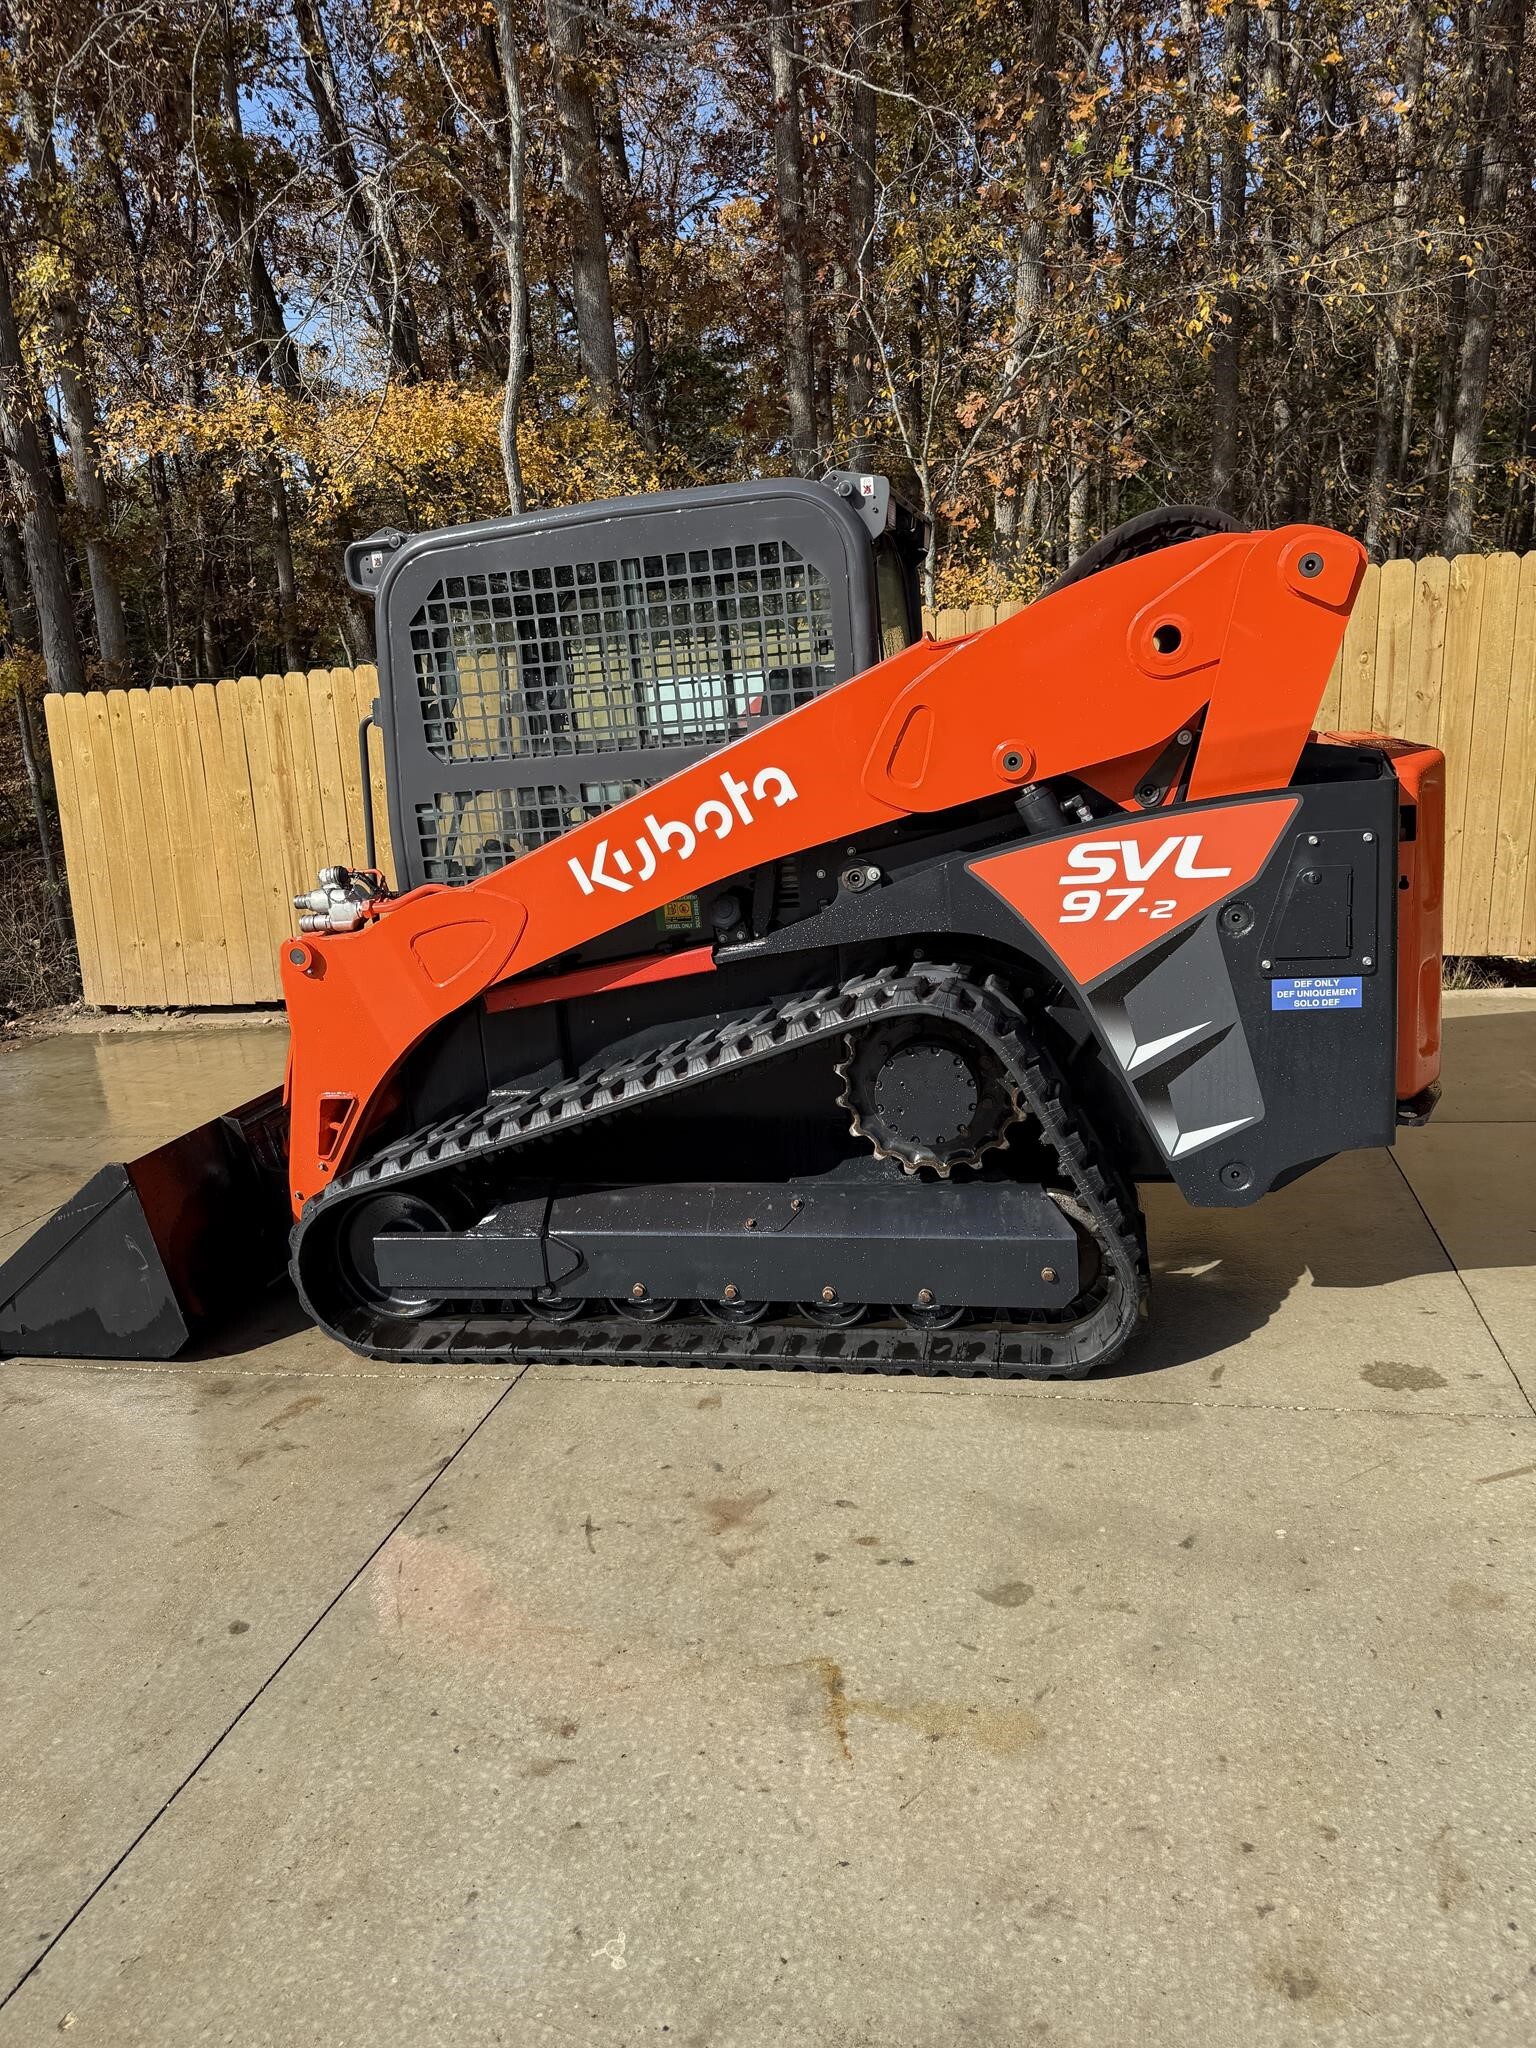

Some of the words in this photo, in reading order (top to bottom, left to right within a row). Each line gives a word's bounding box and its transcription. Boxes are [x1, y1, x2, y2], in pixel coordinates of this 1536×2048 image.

[567, 767, 799, 896] Kubota
[1058, 835, 1232, 885] SVL
[1058, 887, 1178, 923] 97-2
[1276, 990, 1295, 998] DEF
[1296, 988, 1358, 998] UNIQUEMENT
[1314, 979, 1340, 987] ONLY
[1293, 999, 1320, 1007] SOLO
[1321, 998, 1341, 1006] DEF
